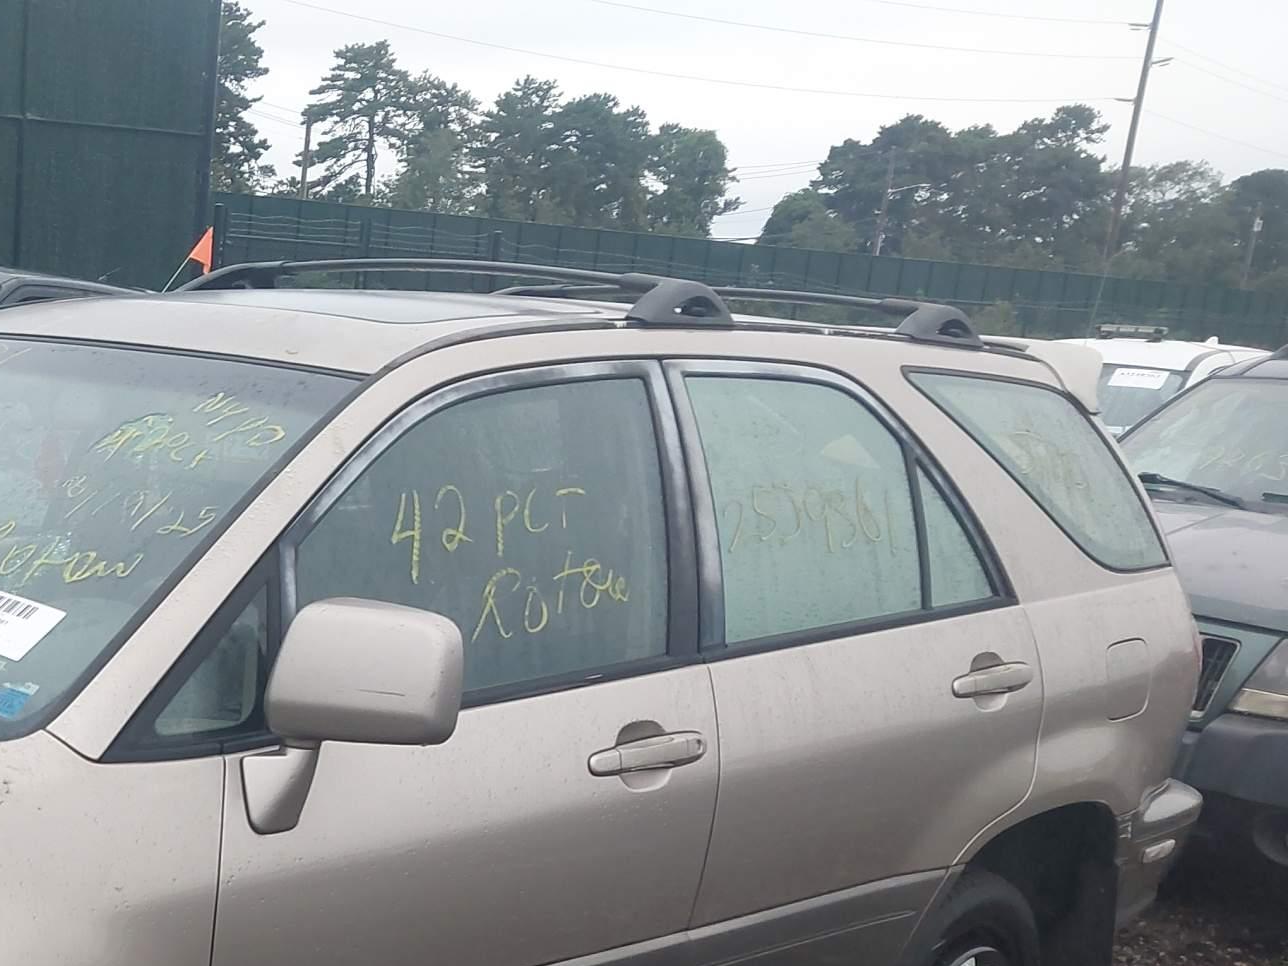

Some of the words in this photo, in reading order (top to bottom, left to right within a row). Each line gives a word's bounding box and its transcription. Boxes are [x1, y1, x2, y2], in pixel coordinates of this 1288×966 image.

[192, 391, 287, 448] NYPD
[391, 485, 473, 585] 42
[494, 488, 586, 557] PCT
